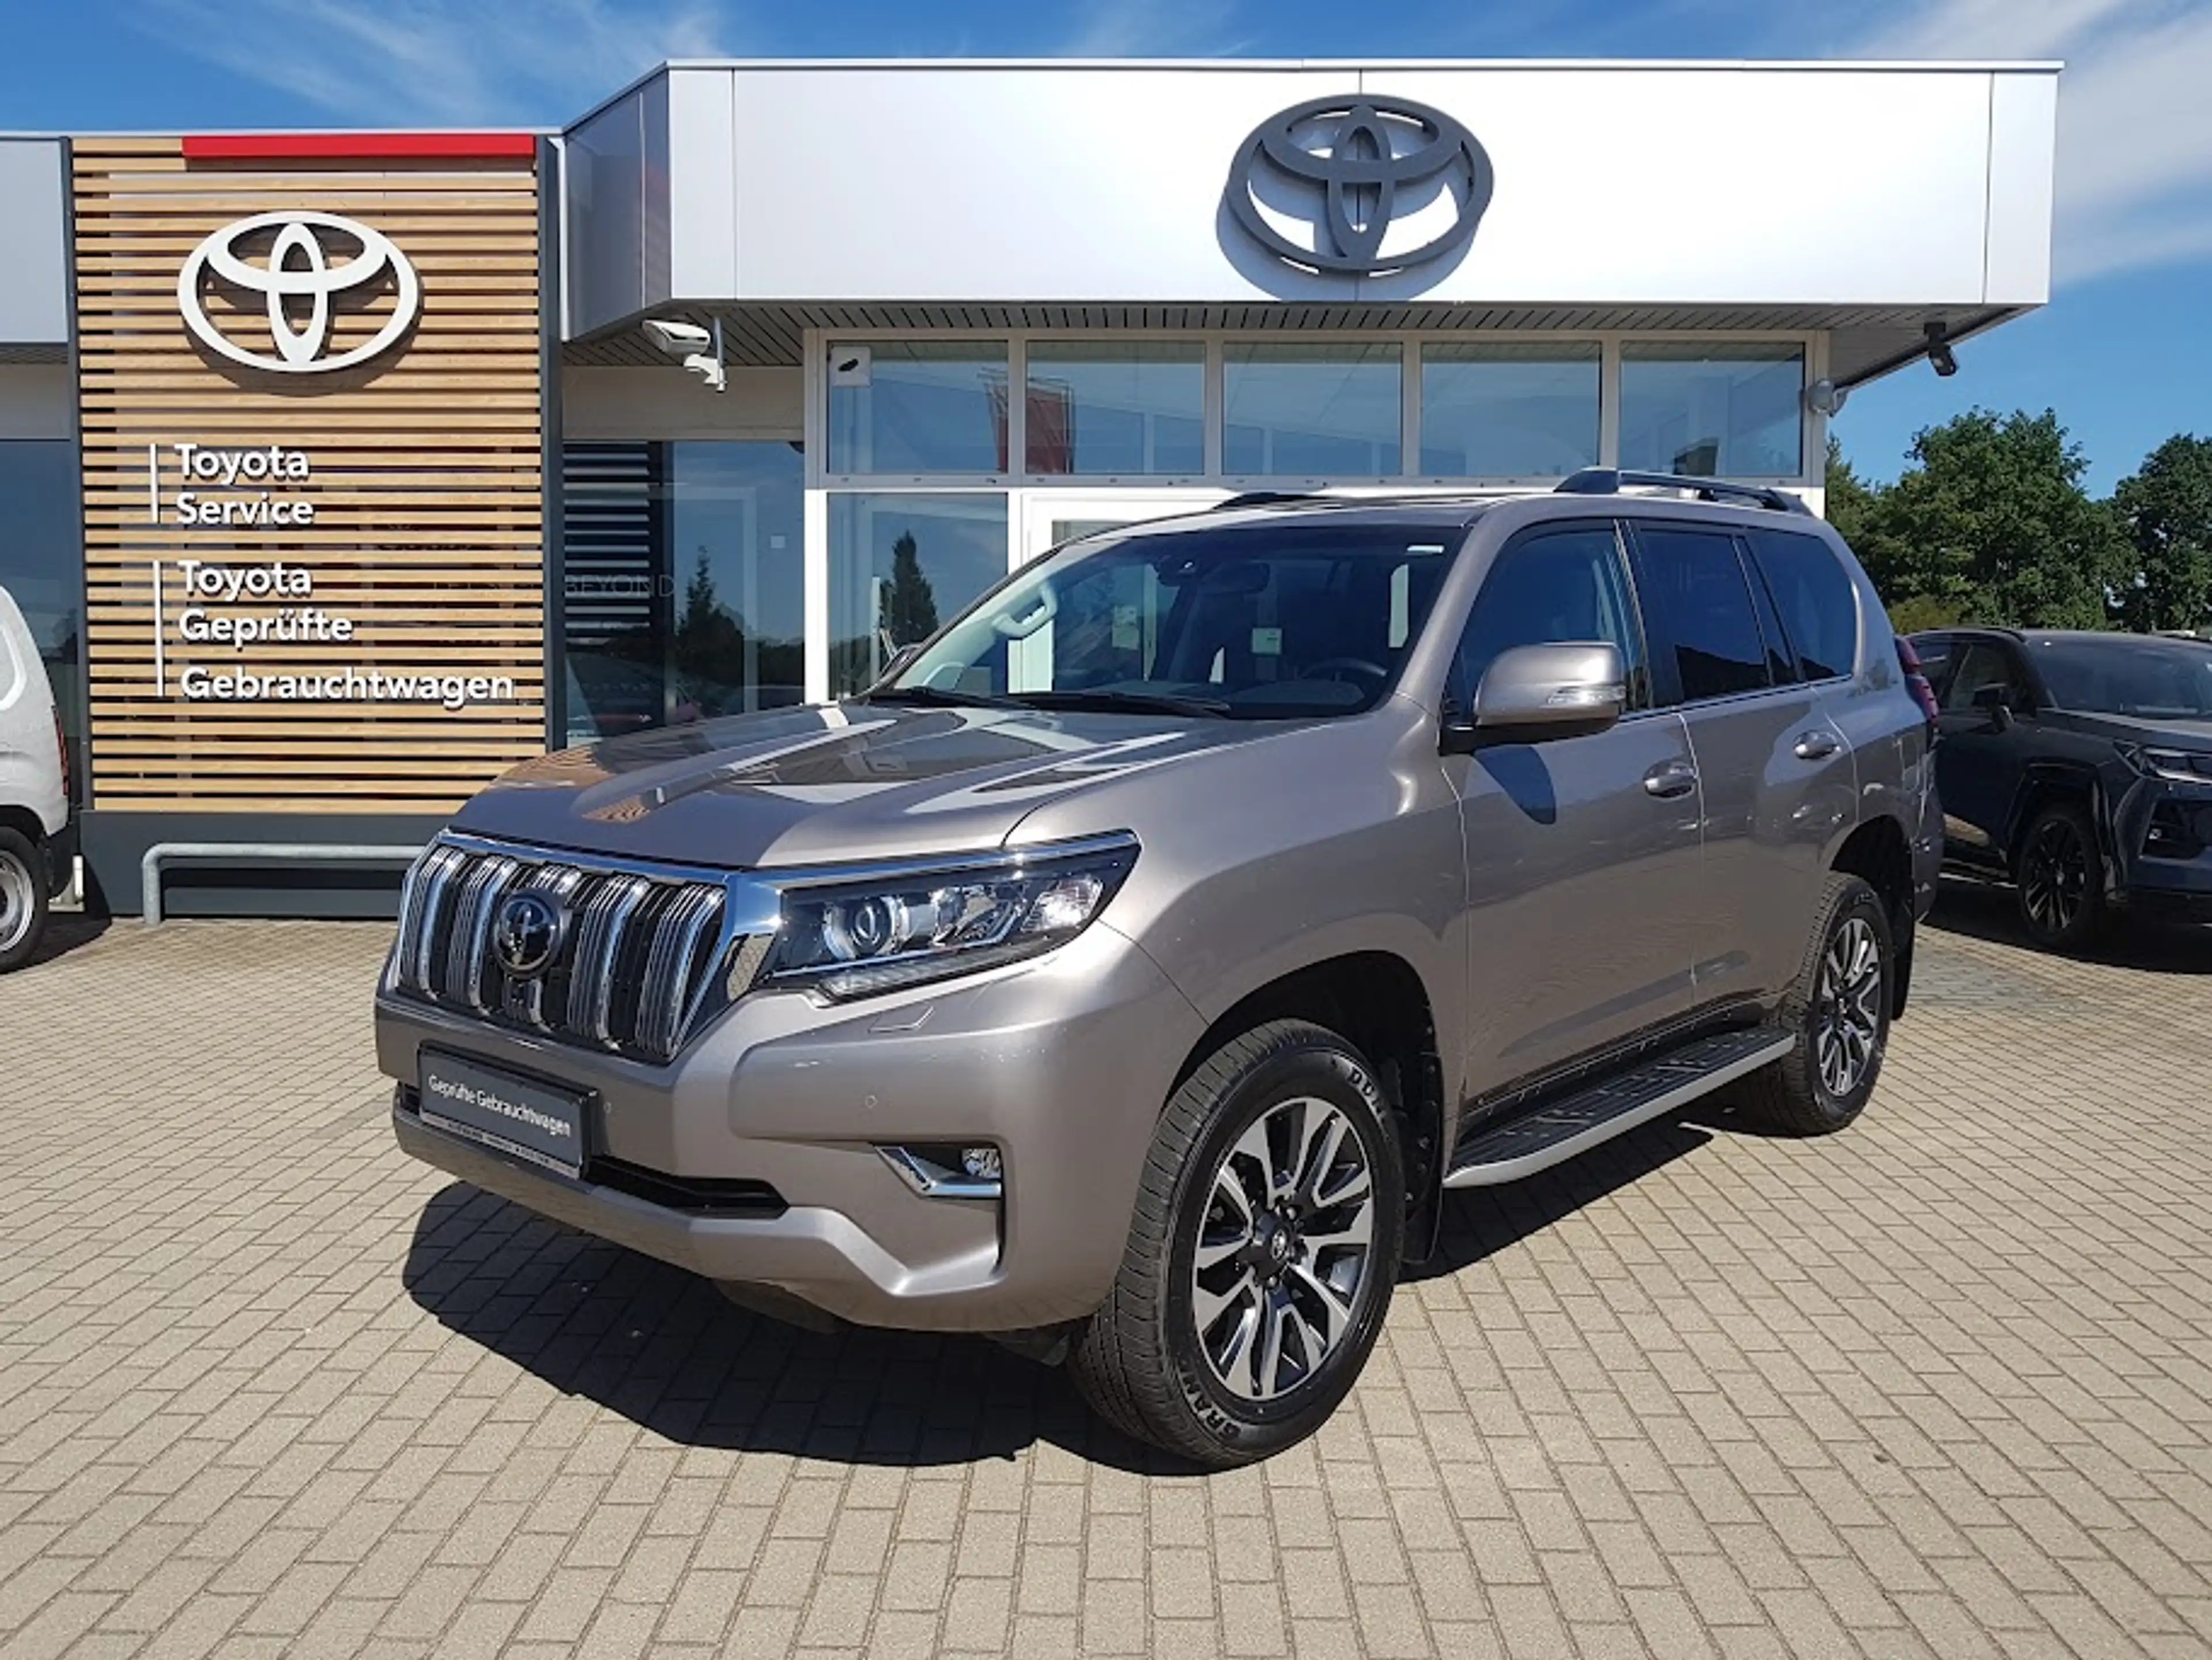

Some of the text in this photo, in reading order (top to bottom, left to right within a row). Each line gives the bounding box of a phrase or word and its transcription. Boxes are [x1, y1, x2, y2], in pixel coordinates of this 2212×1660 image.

[174, 443, 308, 484] Toyota
[176, 492, 313, 524] Service
[178, 560, 310, 601] Toyota
[179, 608, 352, 647] Geprüfte
[180, 666, 513, 707] Gebrauchtwagen
[477, 1090, 571, 1137] Gebrauchtwagen
